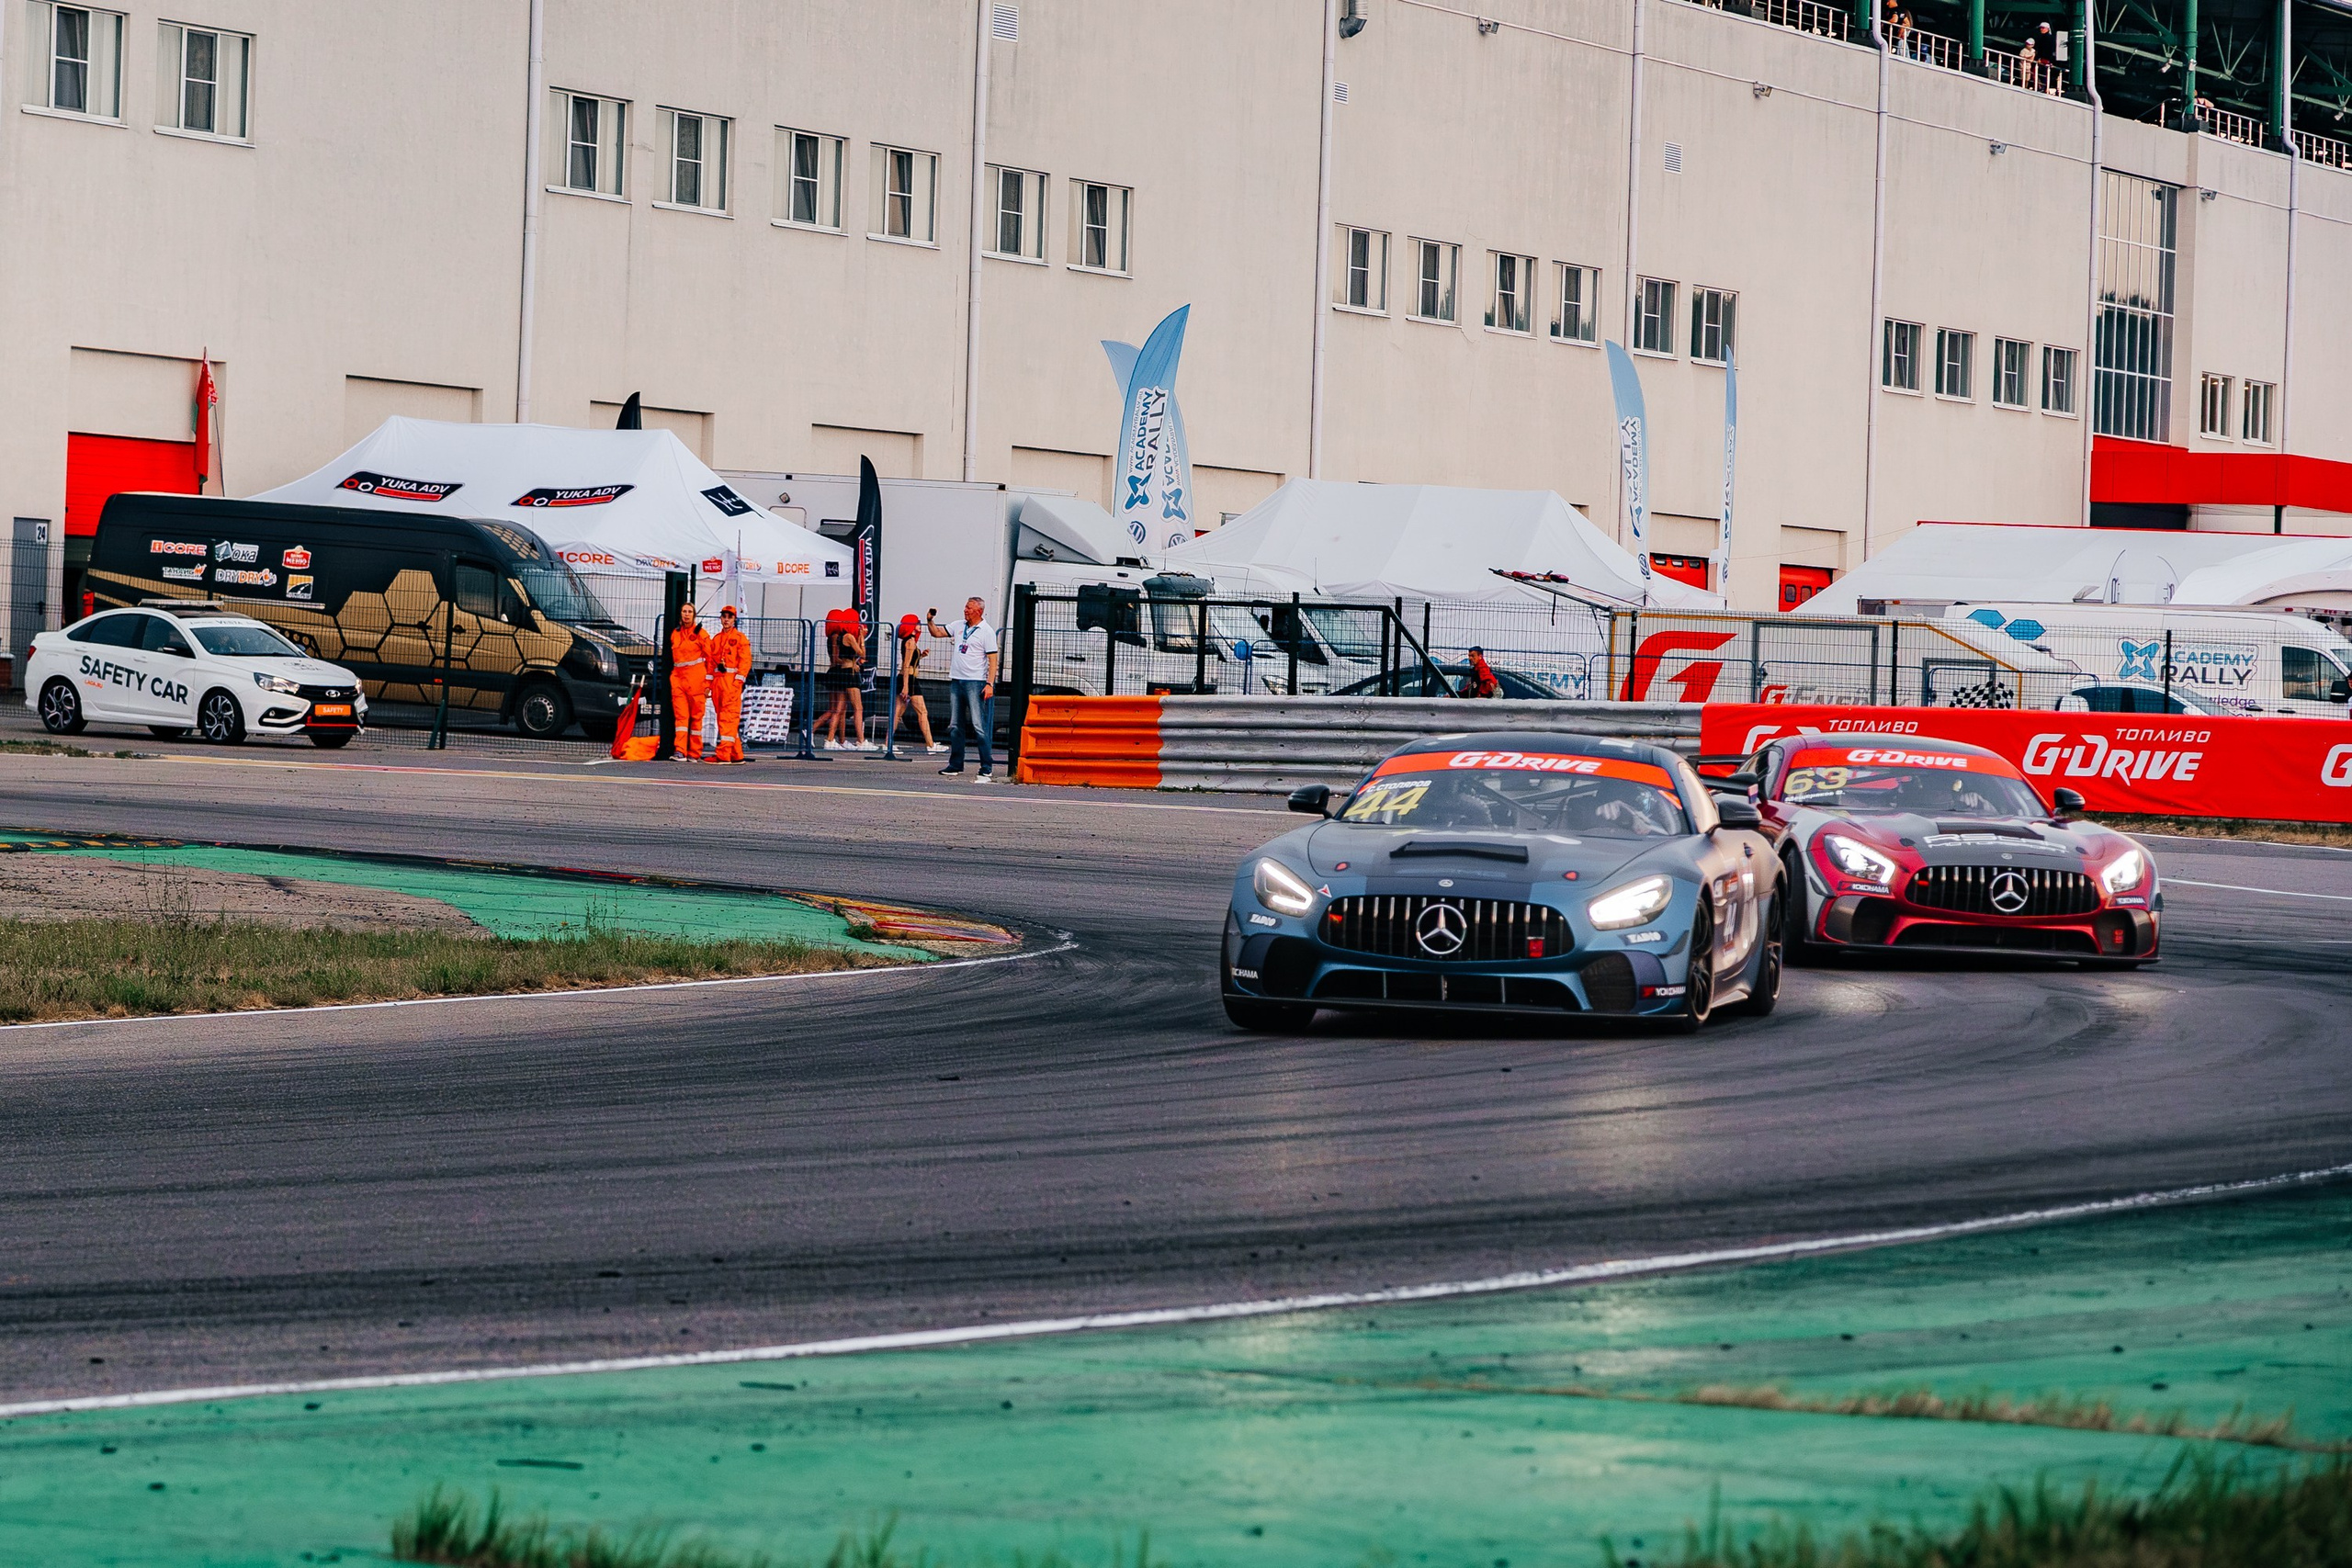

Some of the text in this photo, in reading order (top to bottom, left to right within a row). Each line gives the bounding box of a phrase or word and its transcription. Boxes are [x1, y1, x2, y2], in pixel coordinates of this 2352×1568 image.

[1135, 391, 1153, 471] ACADEMY
[1146, 389, 1166, 470] RALLY
[381, 477, 450, 493] YUKA ADV
[555, 486, 621, 499] YUKA ADV
[37, 525, 46, 540] 24
[79, 655, 188, 705] SAFETY CAR
[1828, 719, 1918, 733] ТОПЛИВО
[2116, 728, 2211, 743] ТОПЛИВО
[1783, 766, 1849, 795] 63
[1343, 786, 1430, 820] 44
